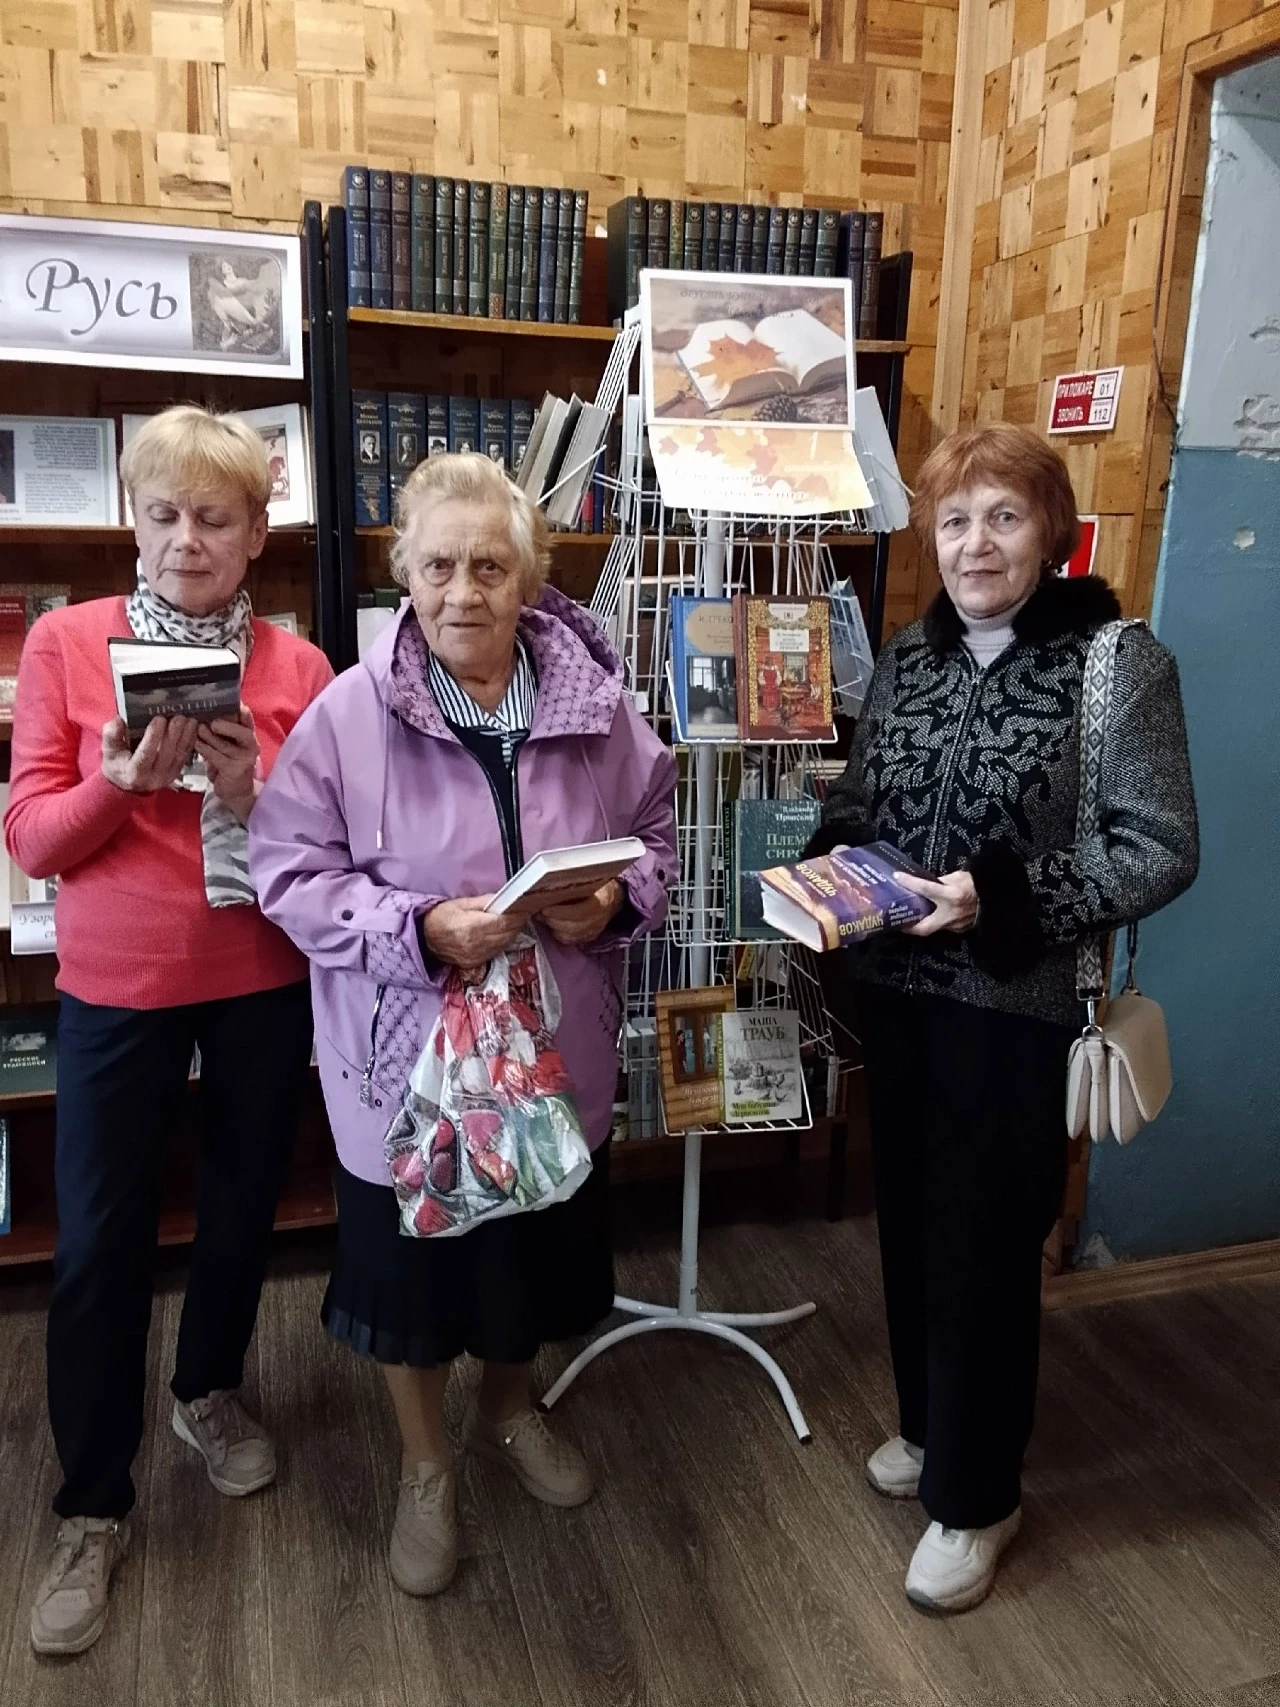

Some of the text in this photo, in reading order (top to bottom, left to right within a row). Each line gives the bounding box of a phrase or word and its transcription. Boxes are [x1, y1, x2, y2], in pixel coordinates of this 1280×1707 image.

[26, 257, 178, 336] Русь
[1069, 381, 1094, 397] ПОЖАРЕ
[1099, 384, 1110, 396] 01
[1094, 408, 1108, 420] 112
[796, 863, 837, 898] ЧУДАКОВ
[839, 911, 883, 936] ЧУДАКОВ
[748, 1016, 778, 1026] МАША
[740, 1025, 785, 1042] ТРАУБ
